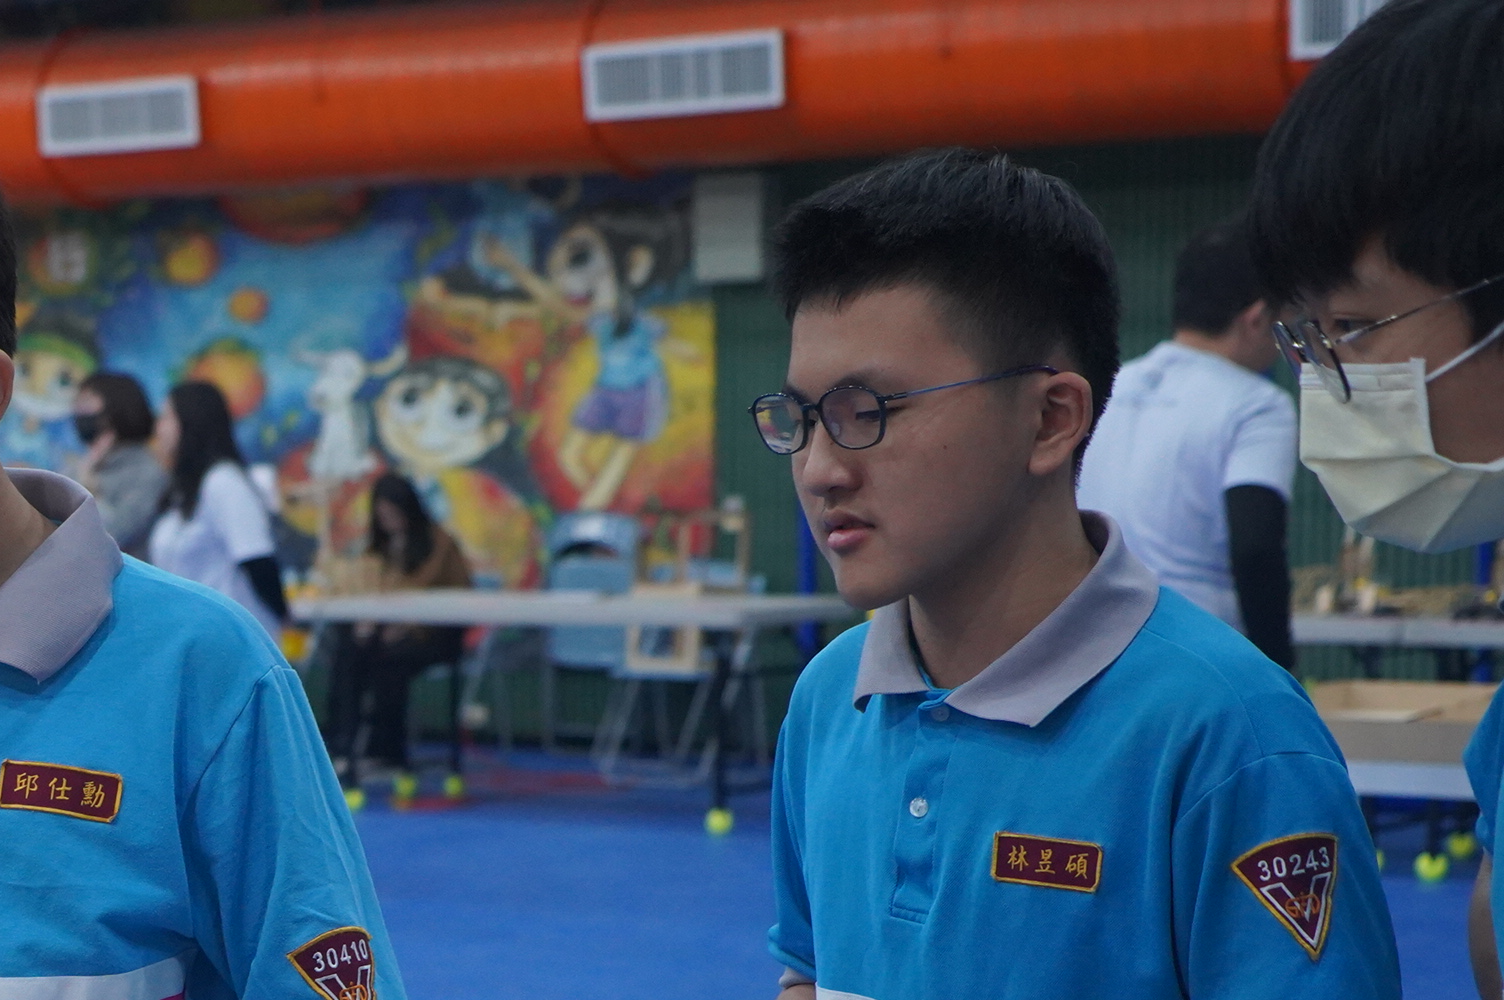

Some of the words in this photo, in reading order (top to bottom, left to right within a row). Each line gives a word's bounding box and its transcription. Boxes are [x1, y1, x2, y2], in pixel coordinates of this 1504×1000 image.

[1007, 844, 1089, 879] 林昱碩
[1257, 846, 1330, 881] 30243
[312, 938, 368, 972] 30410
